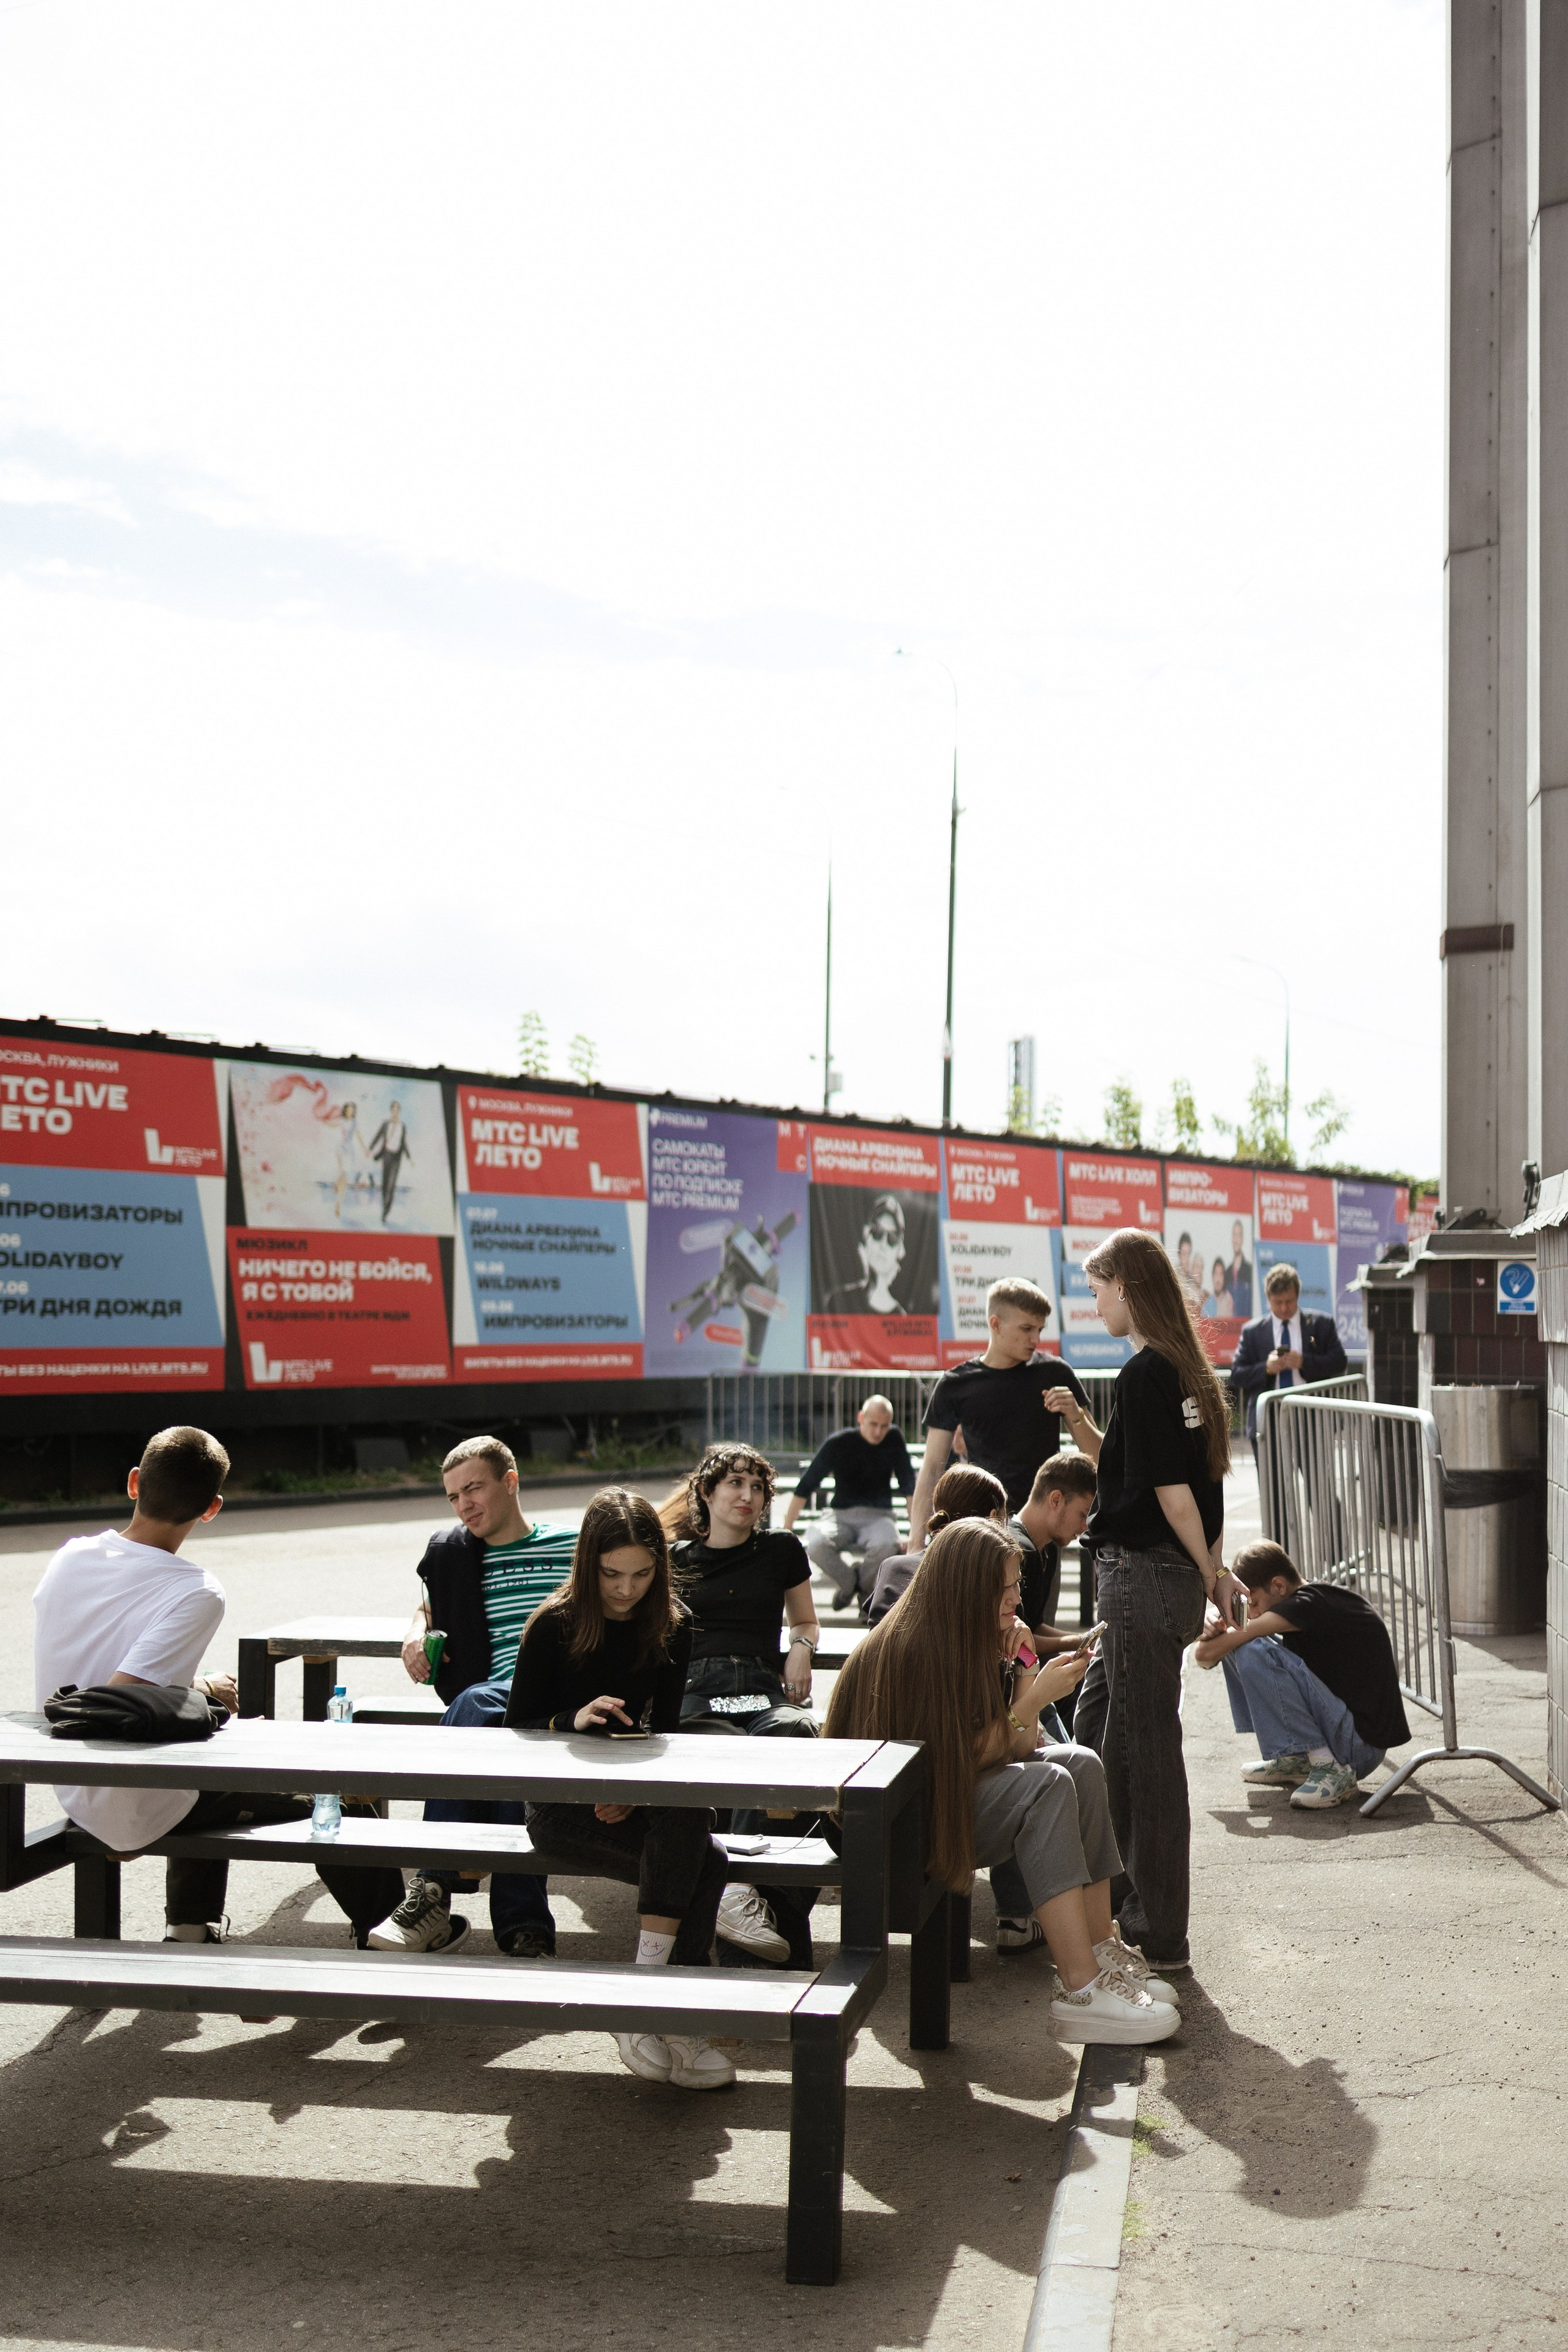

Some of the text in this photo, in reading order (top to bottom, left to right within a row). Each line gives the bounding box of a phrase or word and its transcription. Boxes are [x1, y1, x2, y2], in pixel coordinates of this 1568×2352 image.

[55, 1079, 129, 1112] LIVE
[660, 1110, 708, 1129] PREMIUM
[472, 1117, 579, 1150] МТС LIVE
[475, 1142, 542, 1170] ЛЕТО
[652, 1137, 725, 1159] САМОКАТЫ
[652, 1154, 728, 1177] МТС ЮРЕНТ
[951, 1163, 1020, 1188] МТС LIVE
[1068, 1162, 1097, 1182] МТС
[1098, 1164, 1124, 1184] LIVE
[652, 1170, 673, 1190] ПО
[674, 1172, 744, 1196] ПОДПИСКЕ
[953, 1182, 997, 1205] ЛЕТО
[652, 1189, 739, 1213] МТС PREMIUM
[0, 1200, 183, 1225] ПРОВИЗАТОРЫ
[470, 1221, 601, 1238] ДИАНА АРБЕНИНА
[236, 1237, 308, 1251] МЮЗИКЛ
[472, 1237, 616, 1254] НОЧНЫЕ СНАЙПЕРЫ
[238, 1256, 432, 1285] НИЧЕГО НЕ БОЙСЯ,
[242, 1278, 354, 1303] Я С ТОБОЙ
[477, 1276, 560, 1291] WILDWAYS
[40, 1297, 91, 1318] ДНЯ
[95, 1298, 182, 1319] ДОЖДЯ
[328, 1311, 336, 1321] В
[338, 1310, 380, 1321] ТЕАТРЕ
[483, 1314, 628, 1330] ИМПРОВИЗАТОРЫ
[18, 1364, 45, 1377] БЕЗ
[112, 1362, 130, 1375] НА
[507, 1577, 529, 1587] 1981
